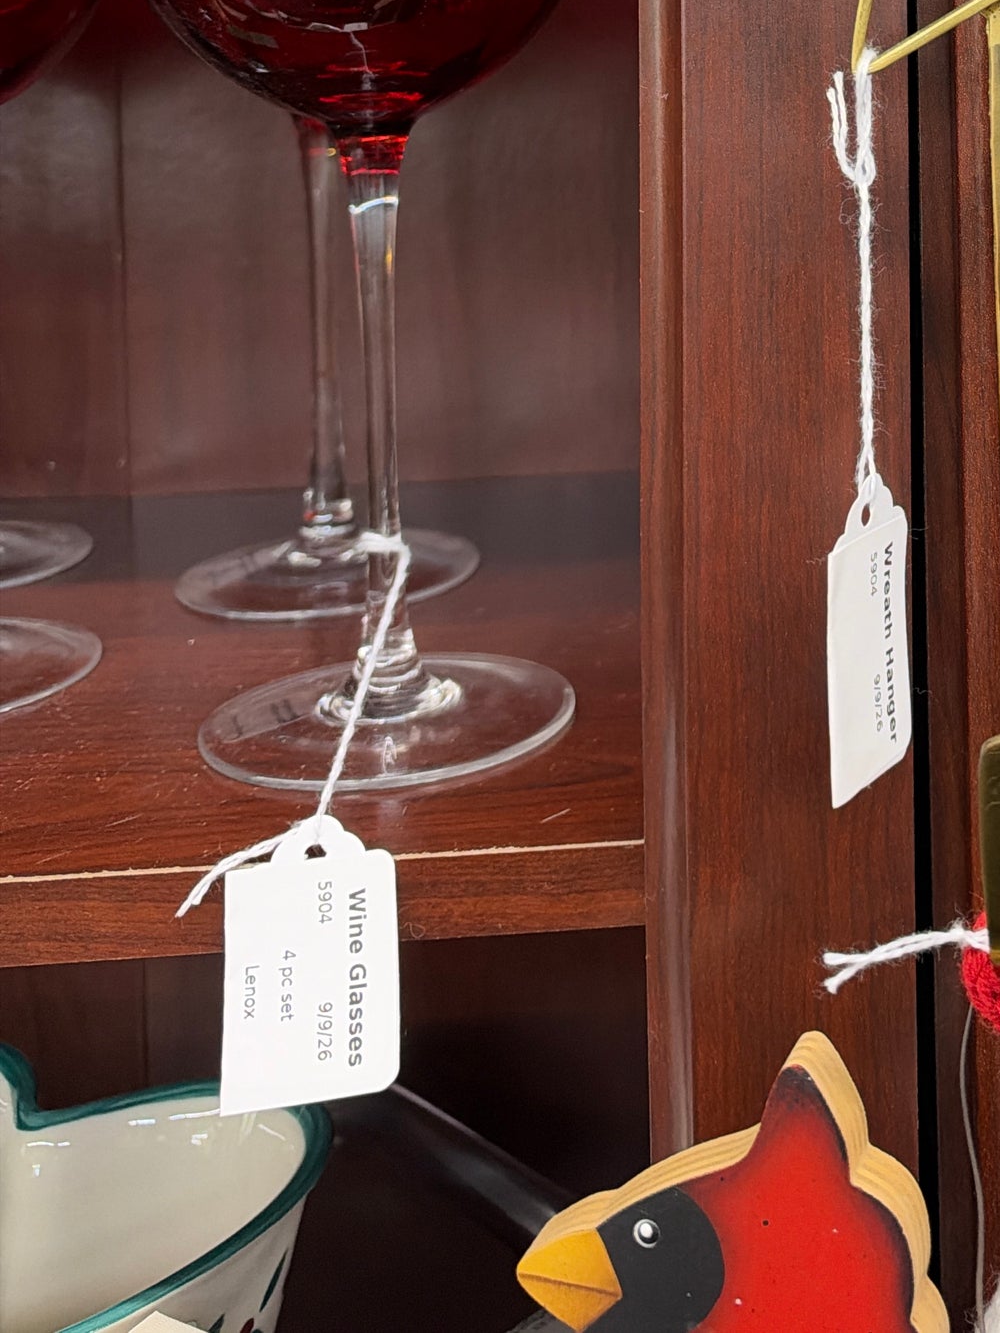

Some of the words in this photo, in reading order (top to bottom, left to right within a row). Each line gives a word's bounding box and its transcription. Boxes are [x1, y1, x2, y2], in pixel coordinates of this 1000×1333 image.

[870, 551, 878, 597] 5904
[883, 541, 893, 640] Wreath
[873, 673, 883, 732] 9/9/26
[885, 647, 897, 743] Hanger
[317, 881, 333, 924] 5904
[348, 888, 367, 954] Wine
[278, 966, 293, 987] pc
[282, 950, 297, 961] 4
[243, 965, 260, 1019] Lenox
[280, 993, 294, 1022] set
[348, 963, 367, 1067] Glasses
[316, 1002, 333, 1061] 9/9/26
